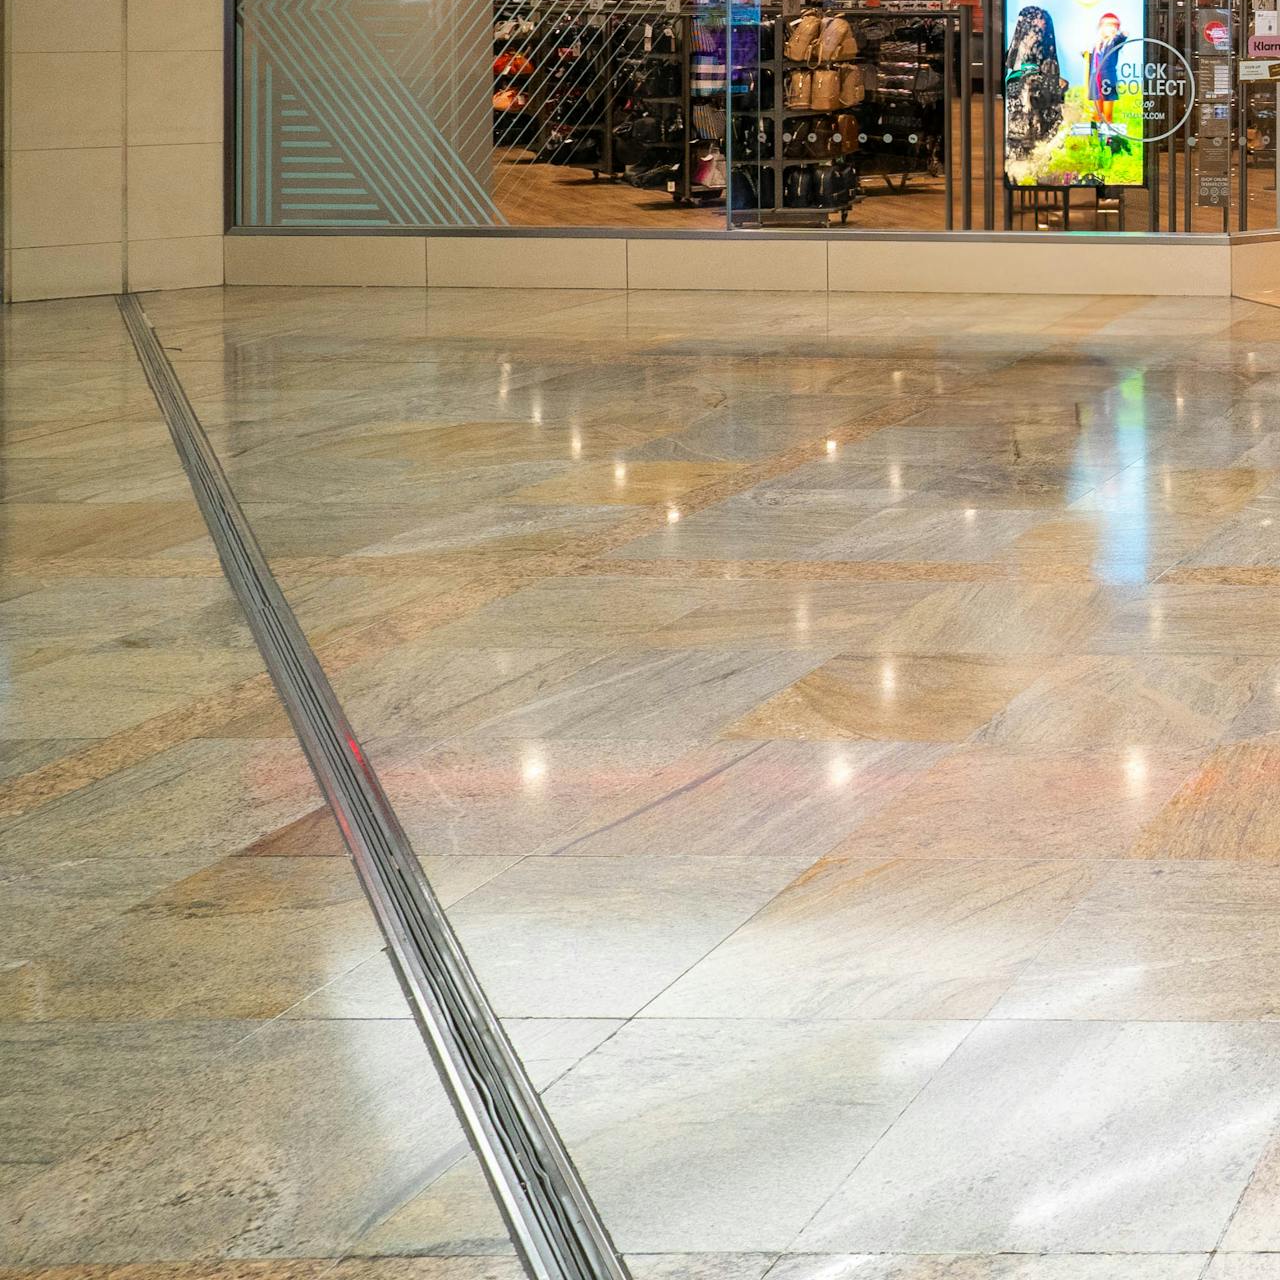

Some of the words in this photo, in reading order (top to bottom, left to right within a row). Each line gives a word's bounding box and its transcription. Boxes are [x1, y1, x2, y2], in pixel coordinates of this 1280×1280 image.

[1120, 63, 1168, 80] CLICK
[1101, 79, 1112, 96] &
[1115, 79, 1187, 97] COLLECT
